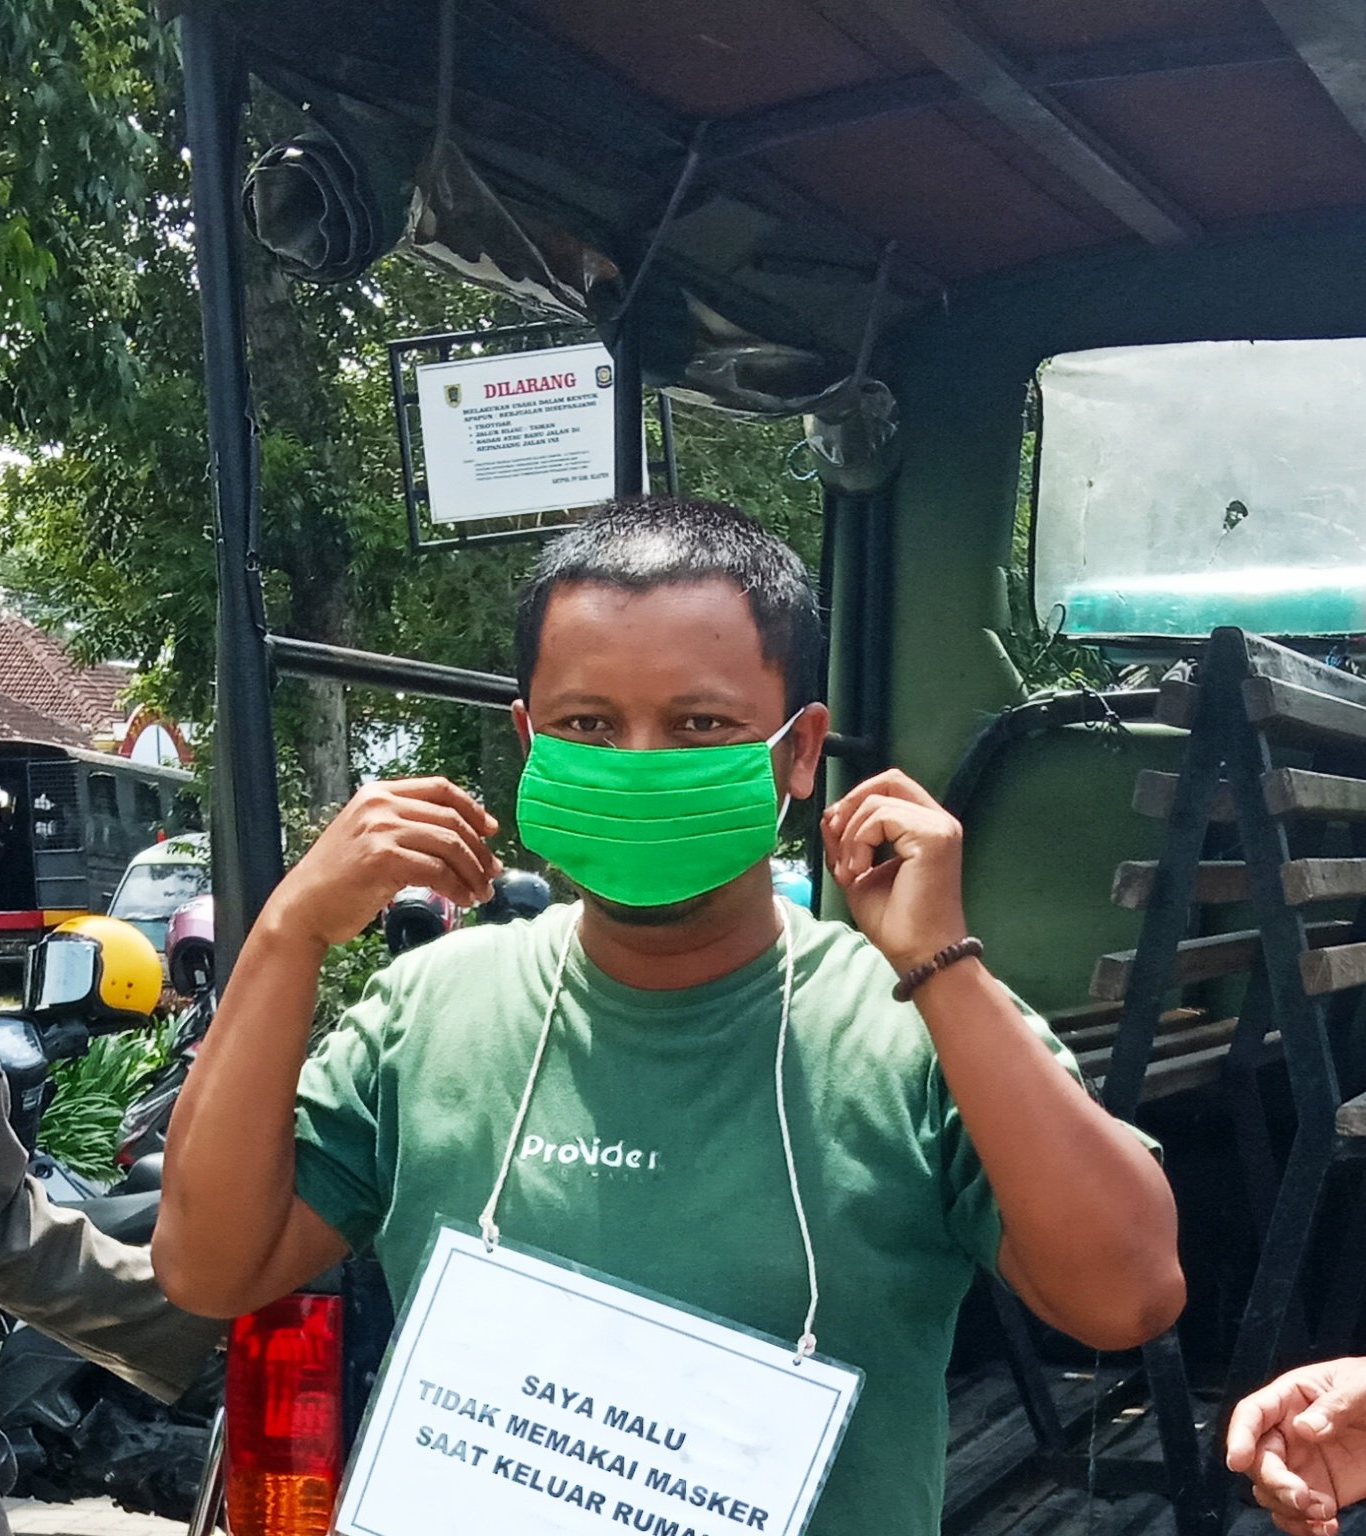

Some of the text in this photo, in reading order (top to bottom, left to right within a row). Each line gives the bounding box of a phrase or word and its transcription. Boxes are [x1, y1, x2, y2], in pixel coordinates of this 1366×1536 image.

[484, 373, 576, 398] DILARANG
[521, 1375, 687, 1452] SAYA MALU
[415, 1425, 489, 1467] SAAT
[492, 1455, 607, 1515] KELUAR
[419, 1380, 770, 1532] TIDAK MEMAKAI MASKER
